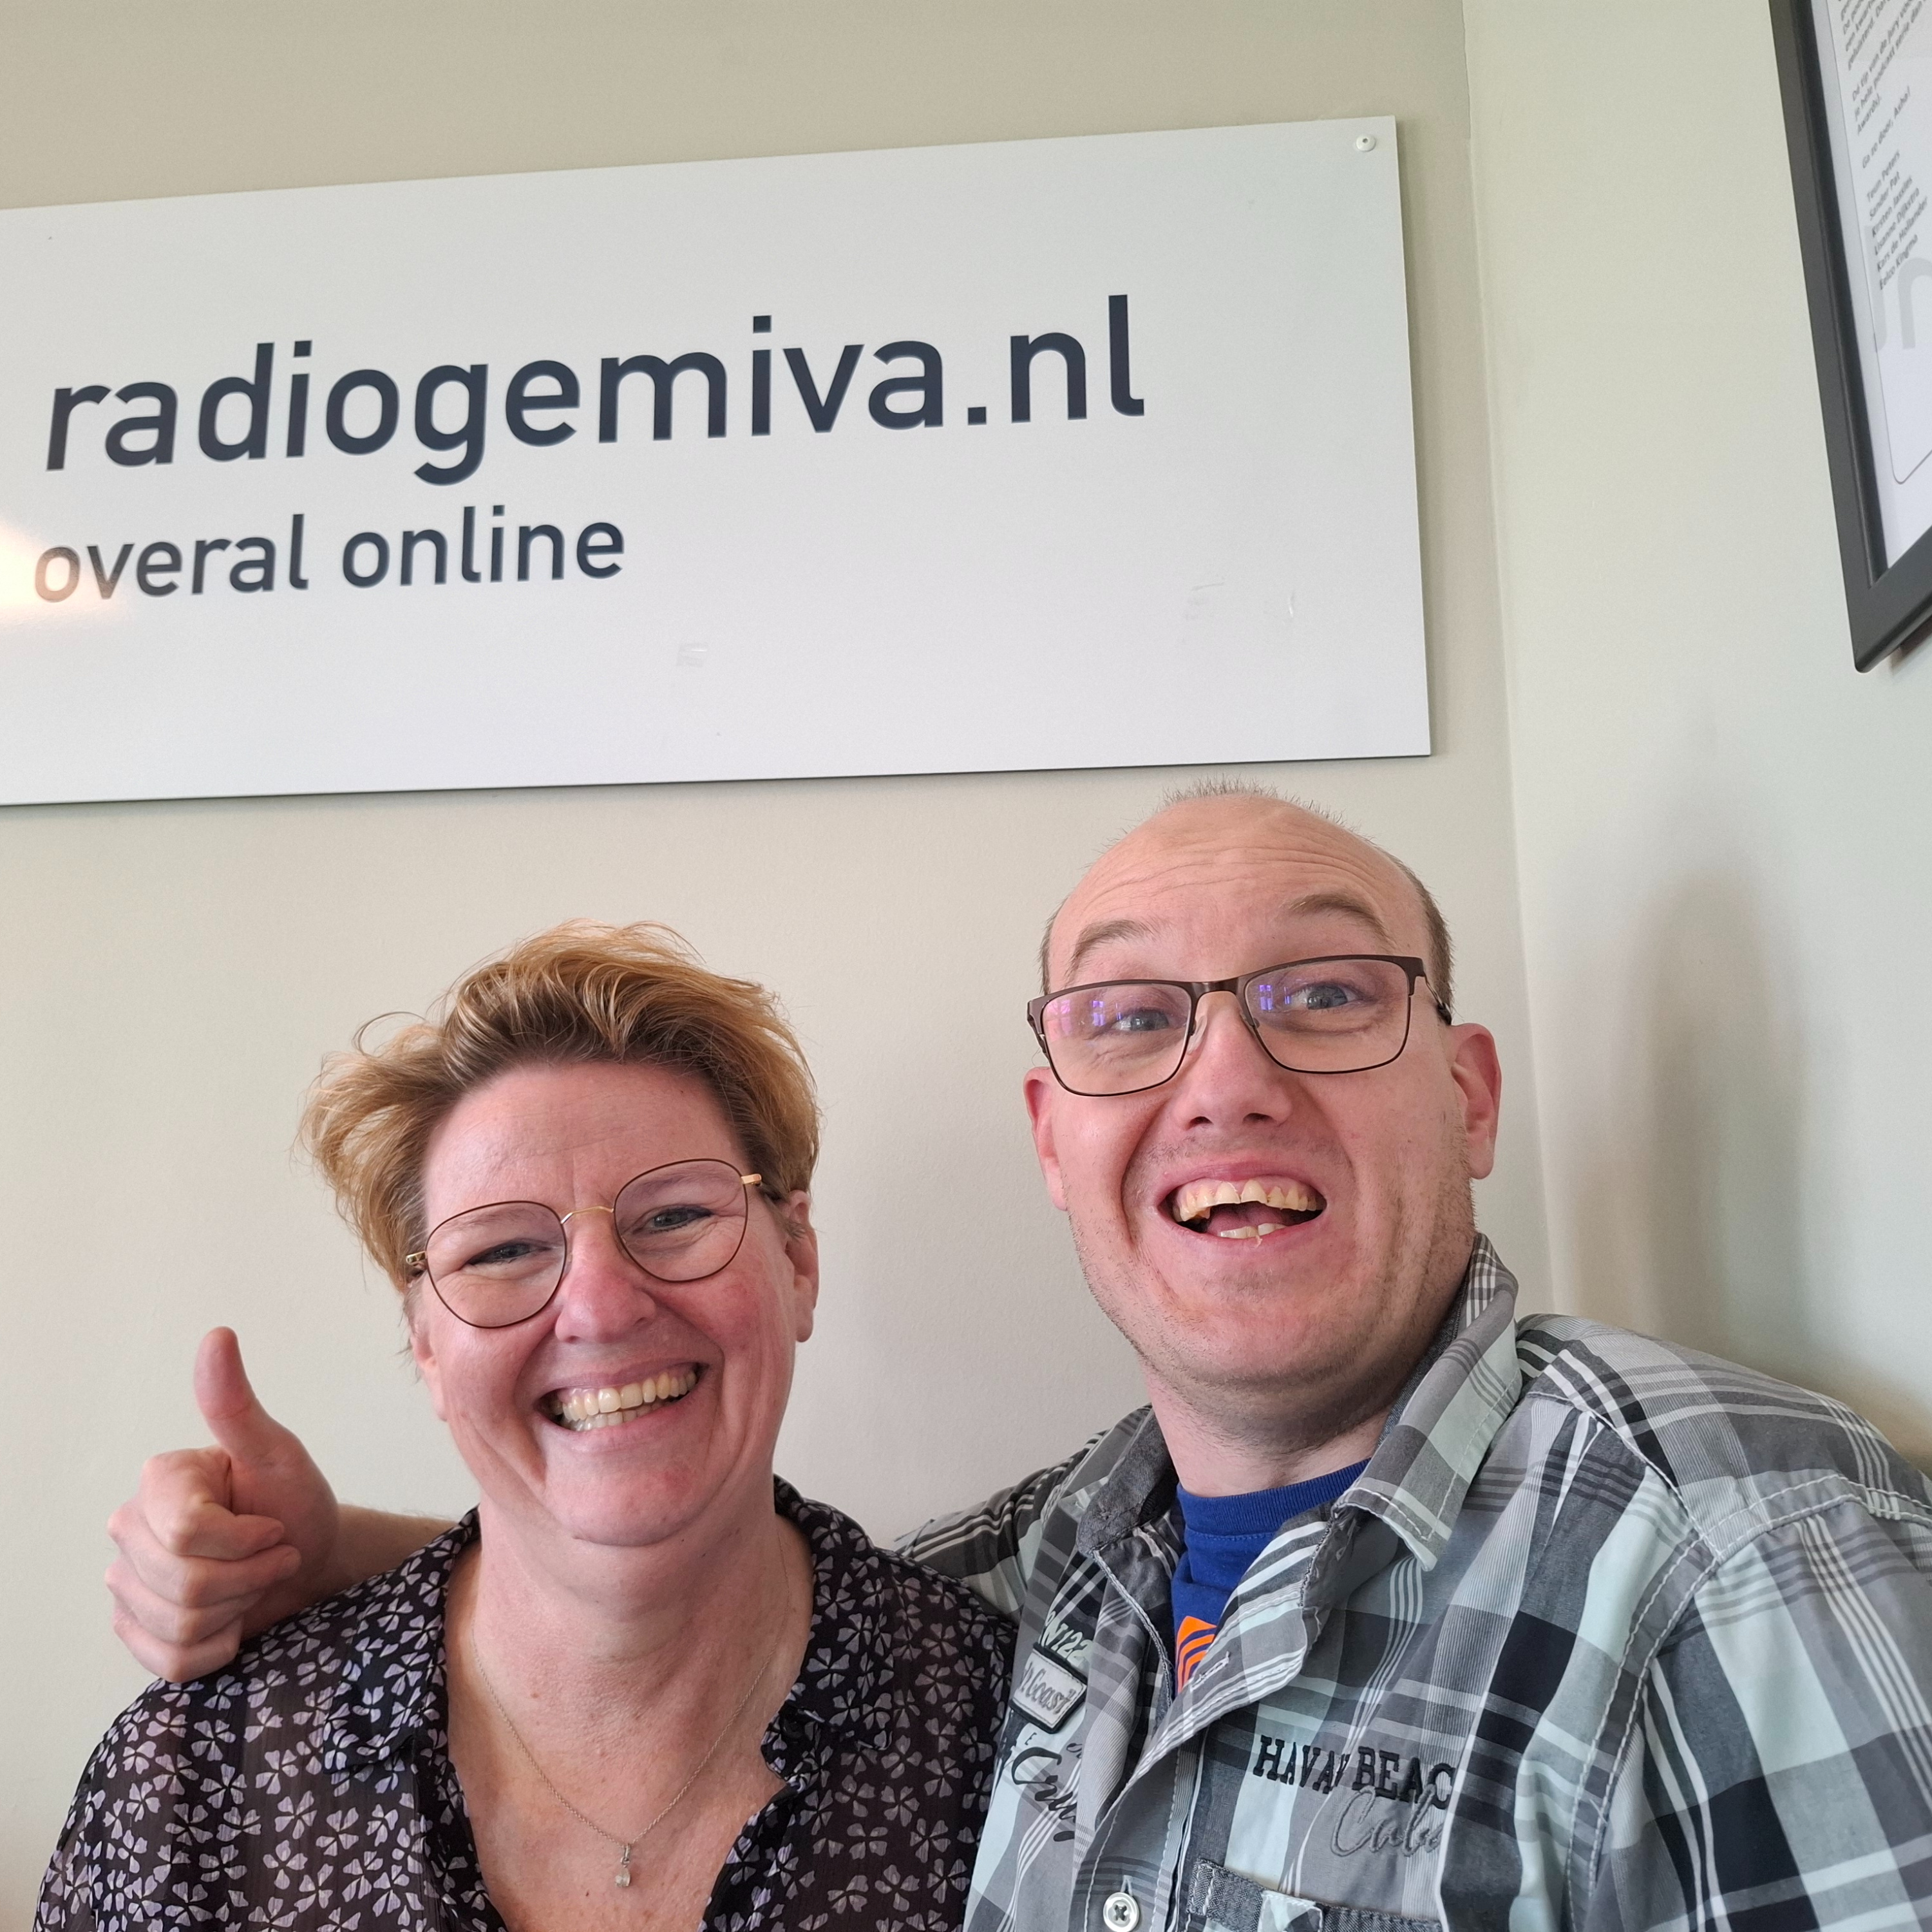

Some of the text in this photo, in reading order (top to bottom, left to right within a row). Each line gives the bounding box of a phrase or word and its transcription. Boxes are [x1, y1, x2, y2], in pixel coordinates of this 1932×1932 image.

[46, 294, 1145, 486] radiogemiva.nl
[33, 504, 625, 603] overal online
